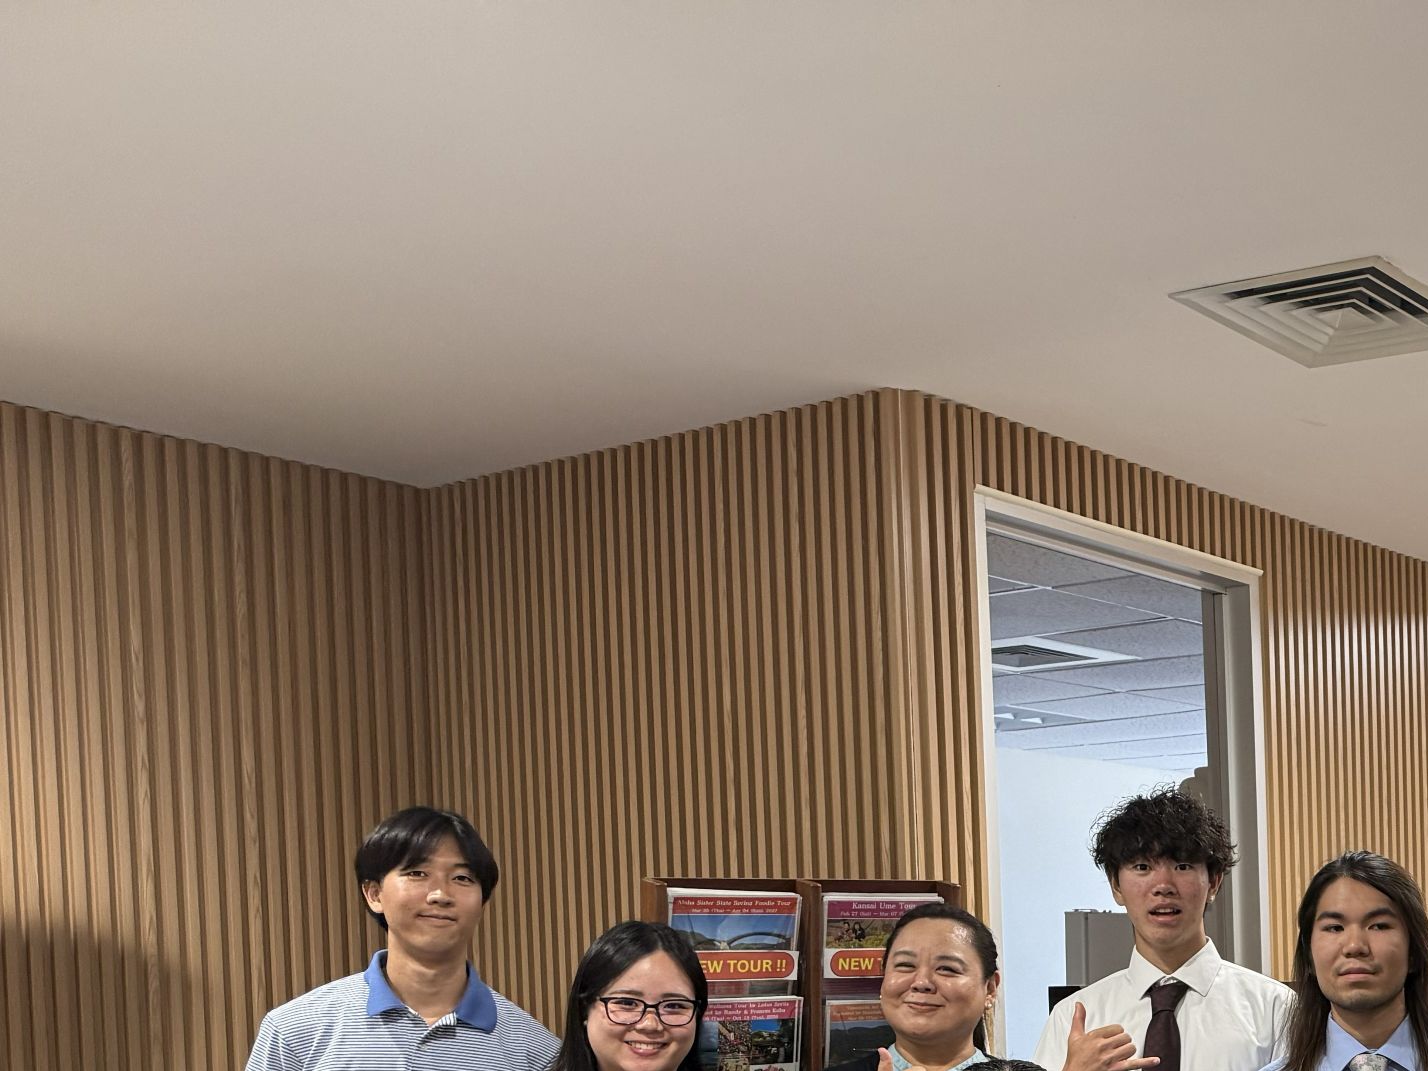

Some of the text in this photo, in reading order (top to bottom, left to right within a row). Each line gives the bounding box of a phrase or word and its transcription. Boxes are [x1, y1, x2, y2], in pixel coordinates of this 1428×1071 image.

[852, 902, 877, 910] Kansai
[879, 902, 897, 910] Ume
[700, 959, 787, 973] EW TOUR !!
[838, 957, 874, 971] NEW
